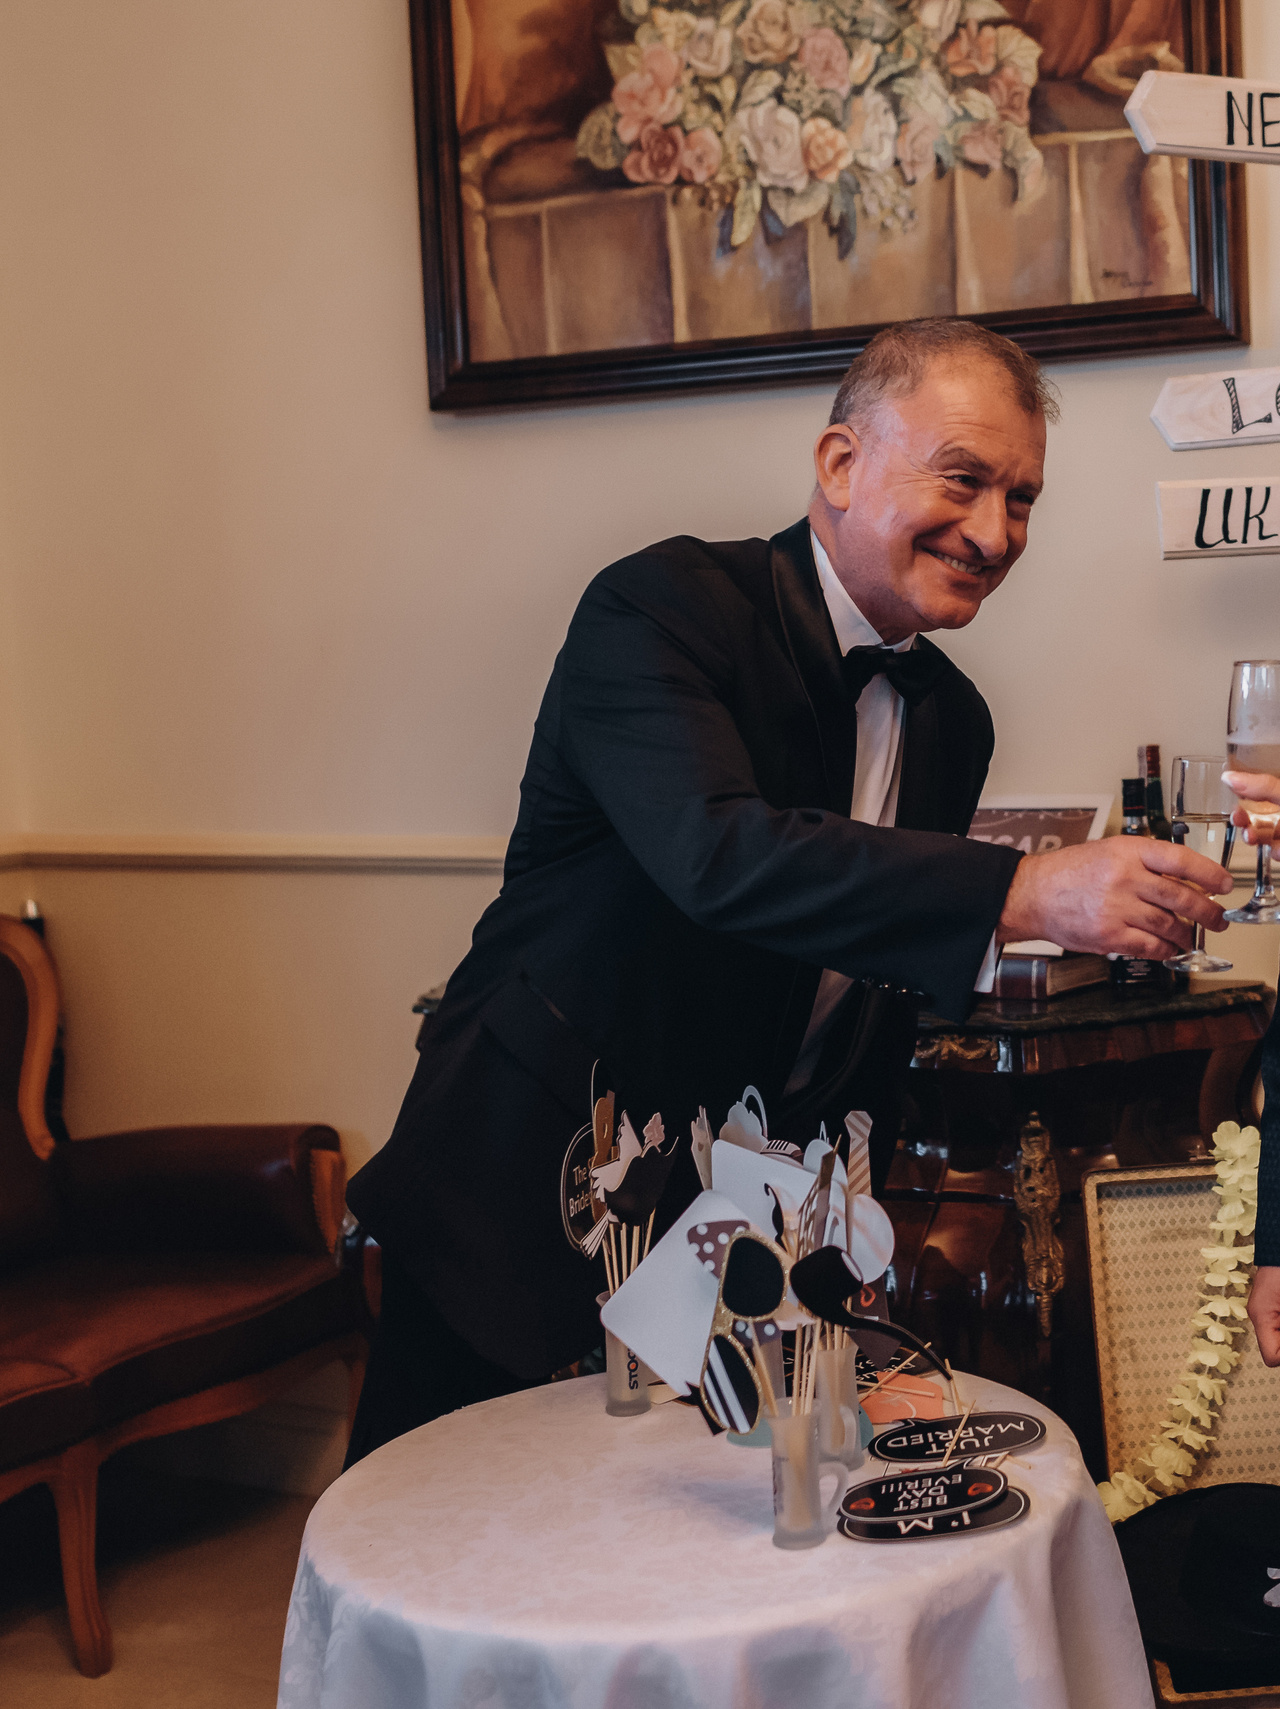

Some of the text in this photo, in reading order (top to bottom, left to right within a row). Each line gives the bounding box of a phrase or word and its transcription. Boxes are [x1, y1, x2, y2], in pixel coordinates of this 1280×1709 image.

[572, 1164, 588, 1186] The
[568, 1190, 595, 1218] Bride
[627, 1347, 639, 1390] STOC
[886, 1420, 1026, 1449] MARRIED
[880, 1473, 963, 1495] EVER!!!
[897, 1485, 945, 1502] DAY
[893, 1494, 949, 1513] BEST
